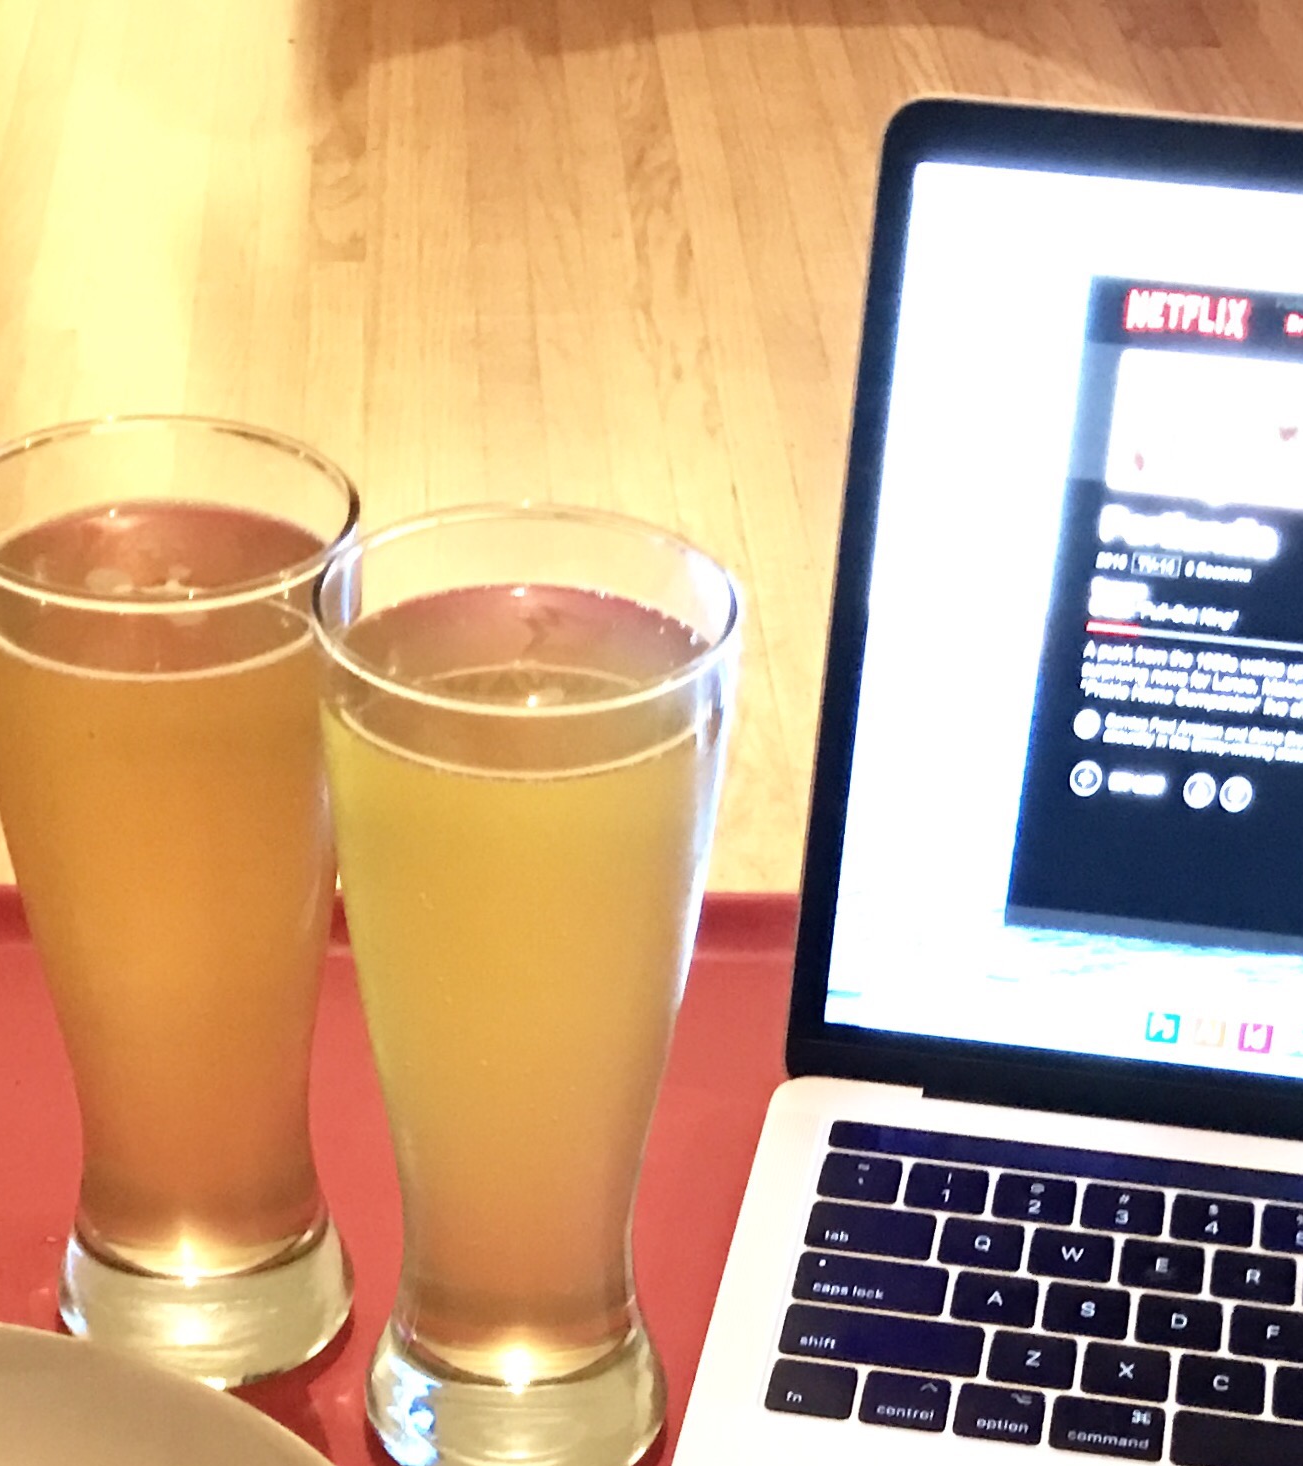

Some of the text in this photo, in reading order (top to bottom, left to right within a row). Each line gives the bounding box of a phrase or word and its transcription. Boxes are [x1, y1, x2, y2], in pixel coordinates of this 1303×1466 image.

[1124, 288, 1249, 340] NETFLIX
[942, 1188, 951, 1203] 1
[1028, 1199, 1042, 1215] 2
[1115, 1209, 1129, 1225] 3
[824, 1229, 849, 1242] tab
[1204, 1220, 1219, 1235] 4
[974, 1235, 992, 1252] Q
[1061, 1245, 1085, 1262] W
[1155, 1257, 1169, 1273] E
[1245, 1268, 1261, 1284] R
[812, 1282, 884, 1300] caps lock
[986, 1290, 1003, 1307] A
[1080, 1301, 1096, 1318] S
[1170, 1312, 1188, 1329] D
[1266, 1324, 1280, 1339] F
[799, 1335, 836, 1350] shift
[1025, 1350, 1042, 1367] Z
[1118, 1361, 1135, 1379] X
[1212, 1374, 1230, 1391] C
[786, 1390, 803, 1403] fn
[876, 1405, 935, 1421] control
[976, 1418, 1029, 1434] option
[1066, 1428, 1150, 1451] command
